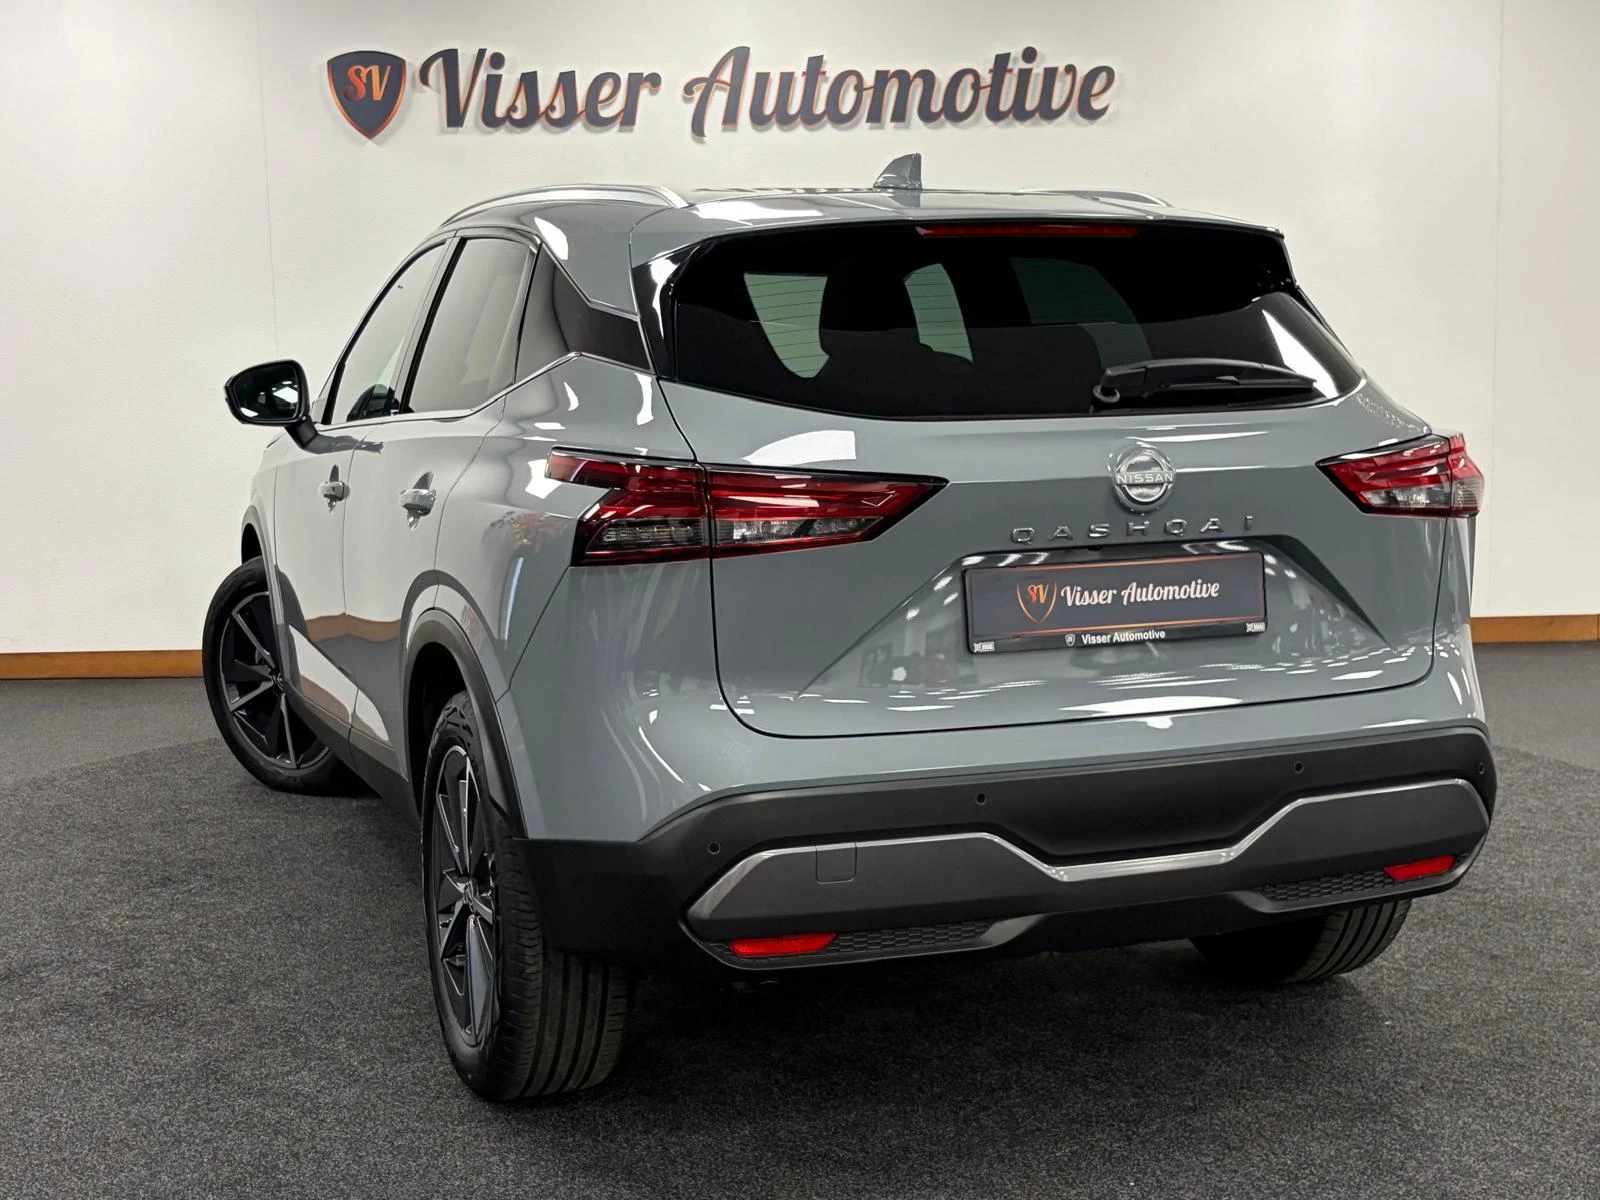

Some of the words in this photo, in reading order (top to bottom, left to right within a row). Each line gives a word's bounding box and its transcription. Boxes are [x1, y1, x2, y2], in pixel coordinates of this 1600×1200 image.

[343, 64, 392, 102] SV
[418, 47, 663, 129] Visser
[682, 45, 1117, 138] Automotive
[1116, 471, 1175, 485] NISSAN
[1010, 515, 1254, 545] QASHQAI
[1060, 585, 1118, 607] Visser
[1120, 578, 1221, 607] Automotive
[1081, 633, 1112, 645] Visser
[1112, 629, 1166, 643] Automotive
